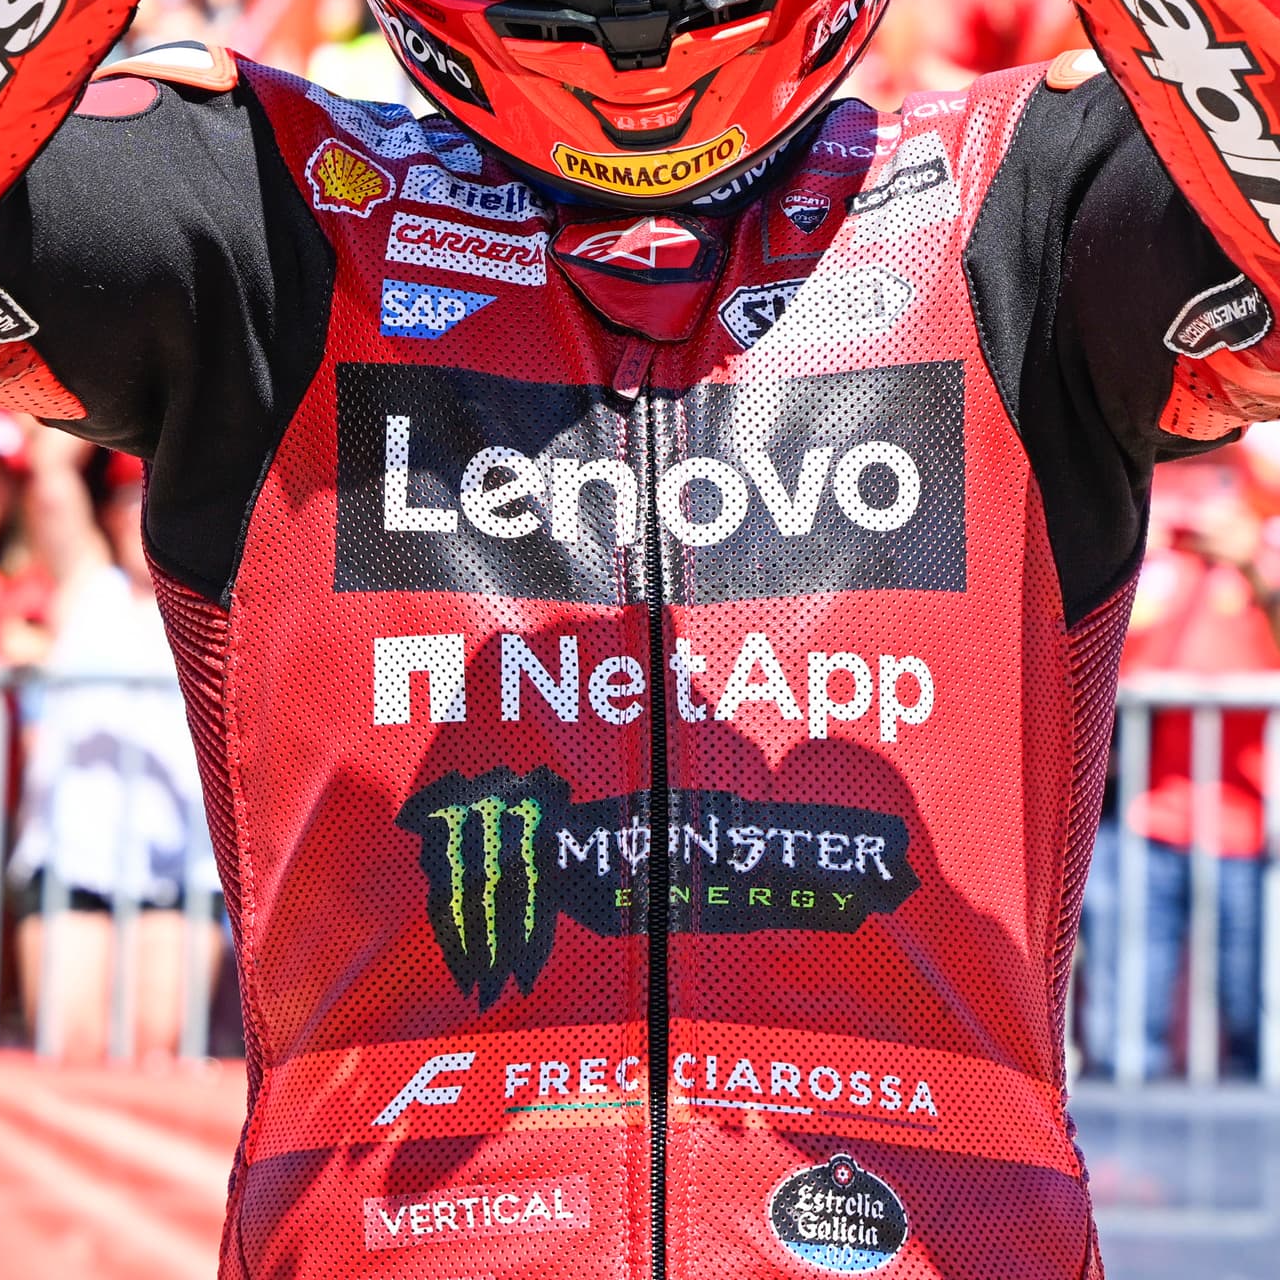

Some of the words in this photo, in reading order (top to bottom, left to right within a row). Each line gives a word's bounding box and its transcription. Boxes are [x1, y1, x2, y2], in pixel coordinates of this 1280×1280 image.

[565, 138, 734, 187] PARMACOTTO
[853, 168, 939, 209] Lenovo
[396, 224, 544, 267] CARRERA
[383, 290, 466, 330] SAP
[382, 414, 920, 547] Lenovo
[501, 631, 935, 743] NetApp
[555, 813, 894, 881] MONSTER
[615, 885, 853, 910] ENERGY
[504, 1052, 938, 1117] FRECCIAROSSA
[378, 1189, 573, 1237] VERTICAL
[794, 1184, 884, 1219] Estrella
[797, 1212, 879, 1245] Galicia
